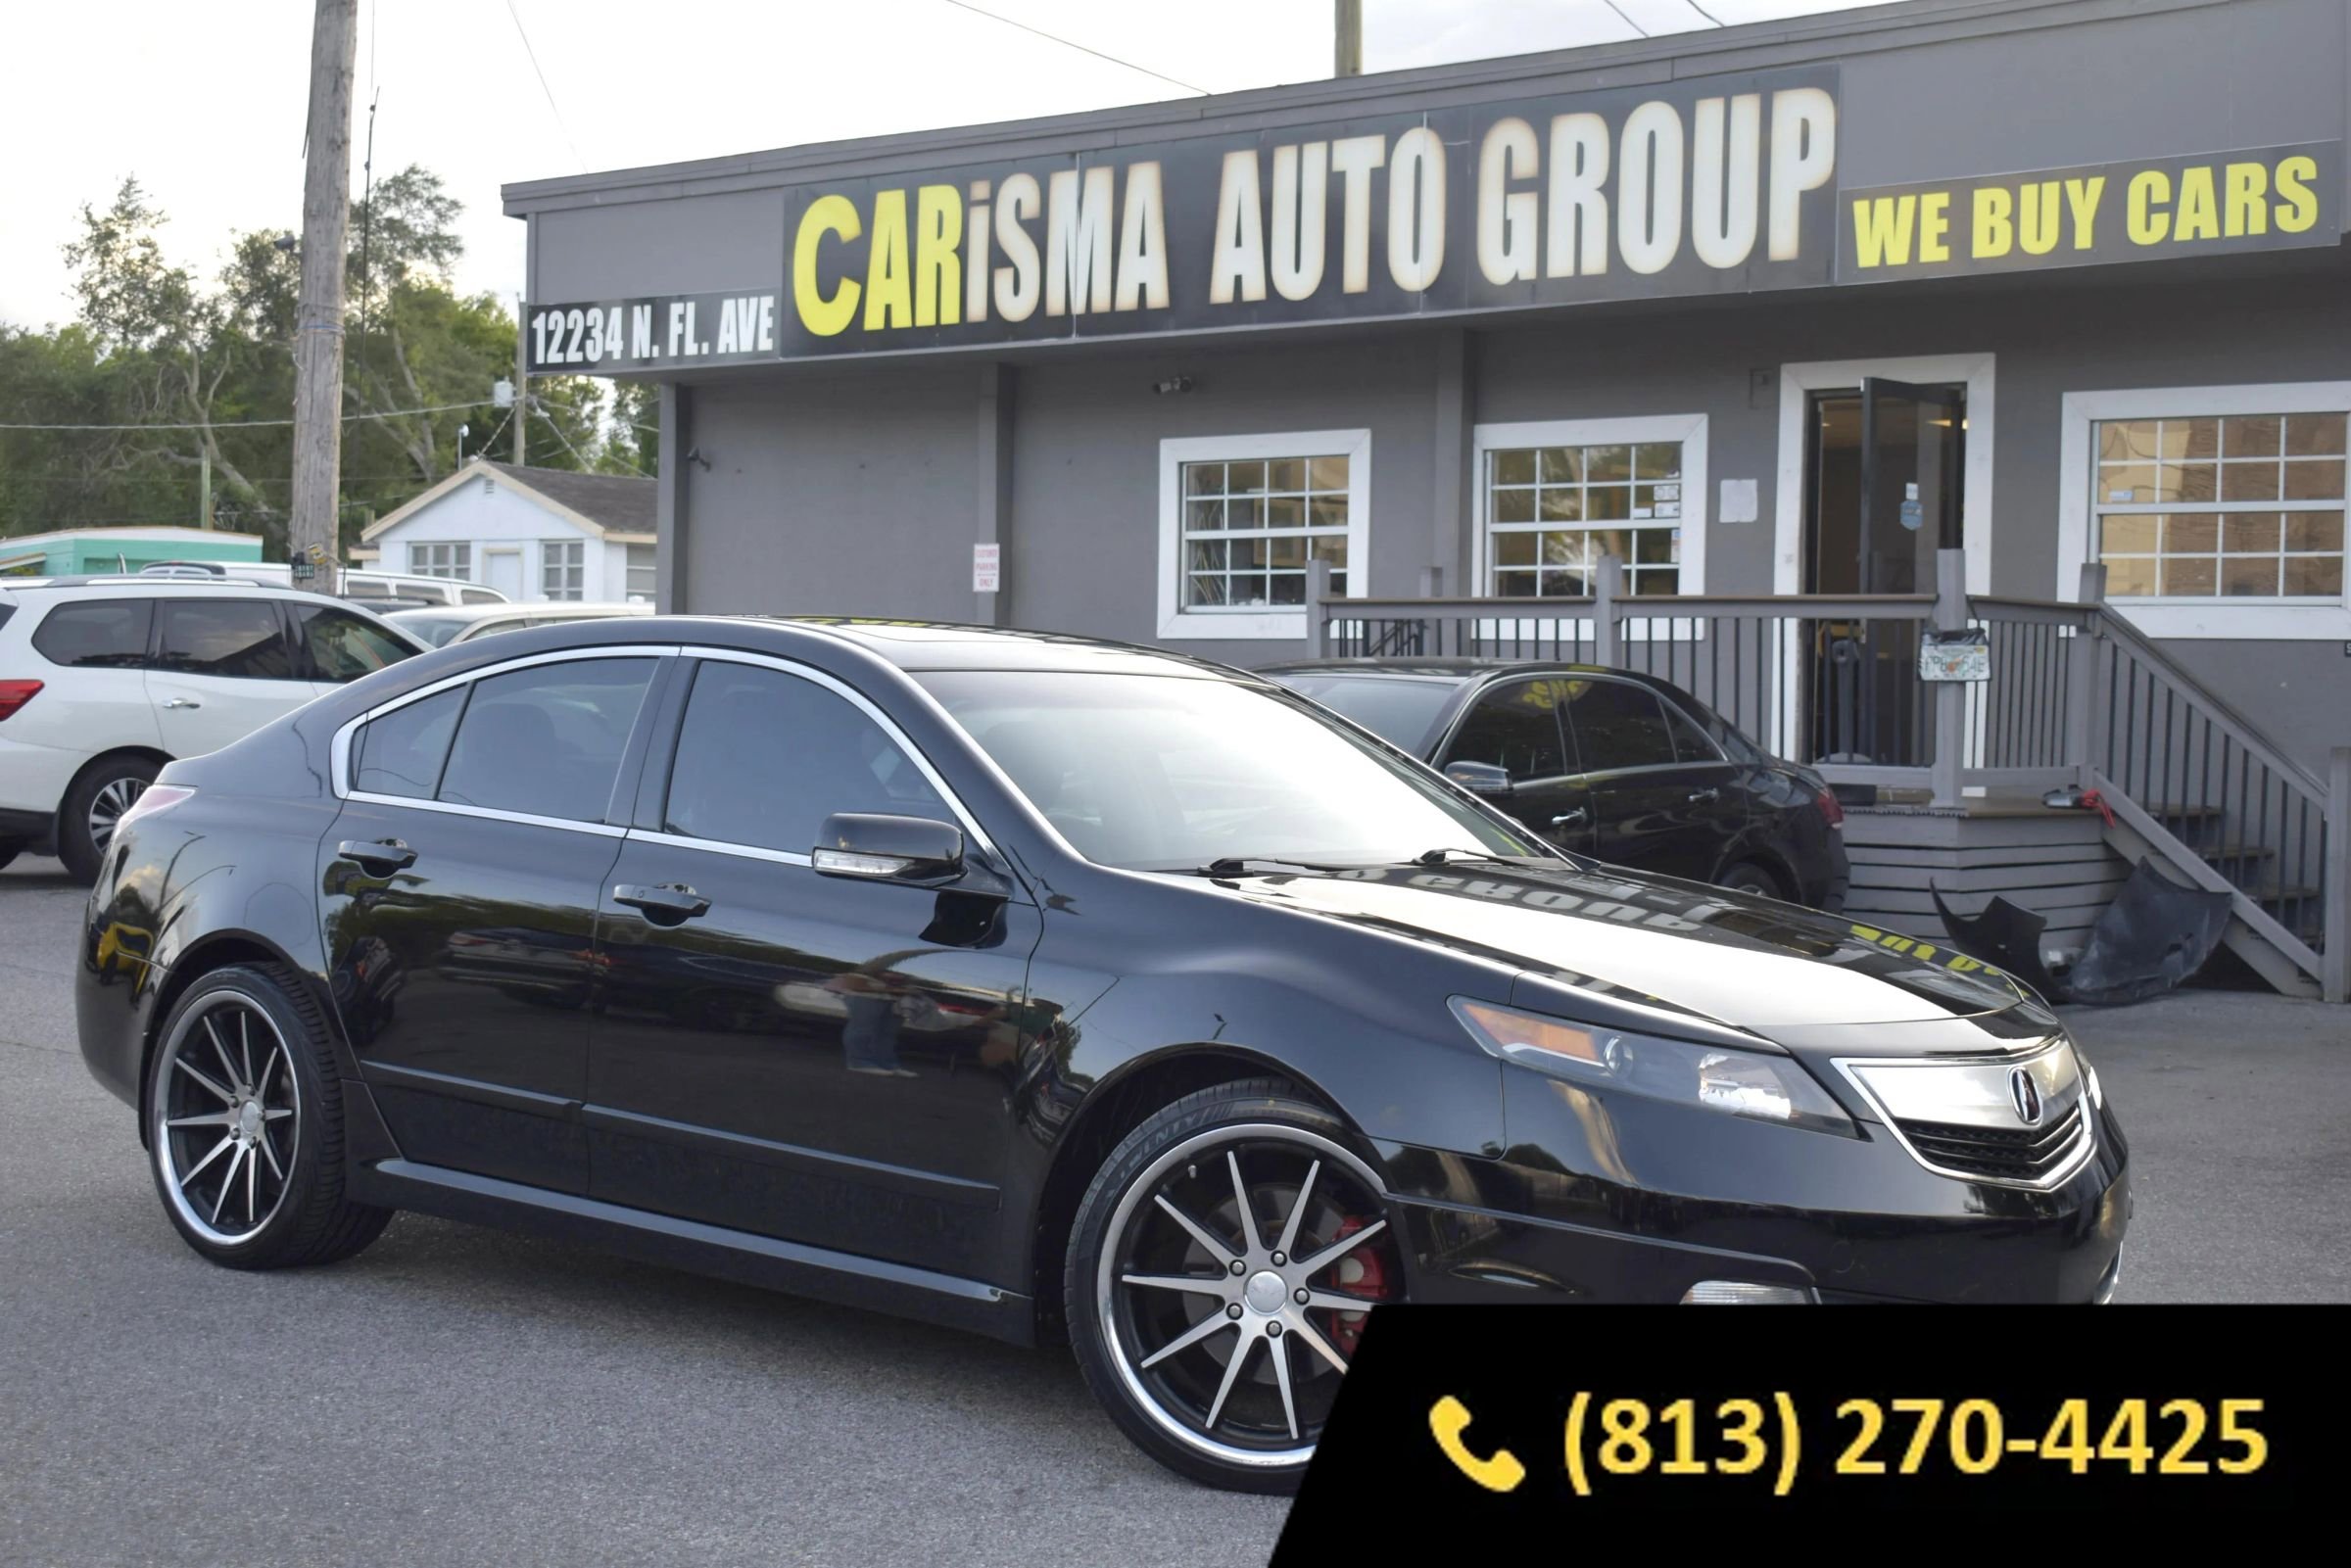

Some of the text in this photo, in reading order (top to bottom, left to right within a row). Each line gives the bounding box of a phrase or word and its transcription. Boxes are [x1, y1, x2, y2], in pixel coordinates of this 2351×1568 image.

[1210, 126, 1446, 304] AUTO
[1476, 88, 1836, 286] GROUP
[1853, 156, 2319, 267] WE BUY CARS
[532, 295, 776, 364] 12234 N. FL. AVE
